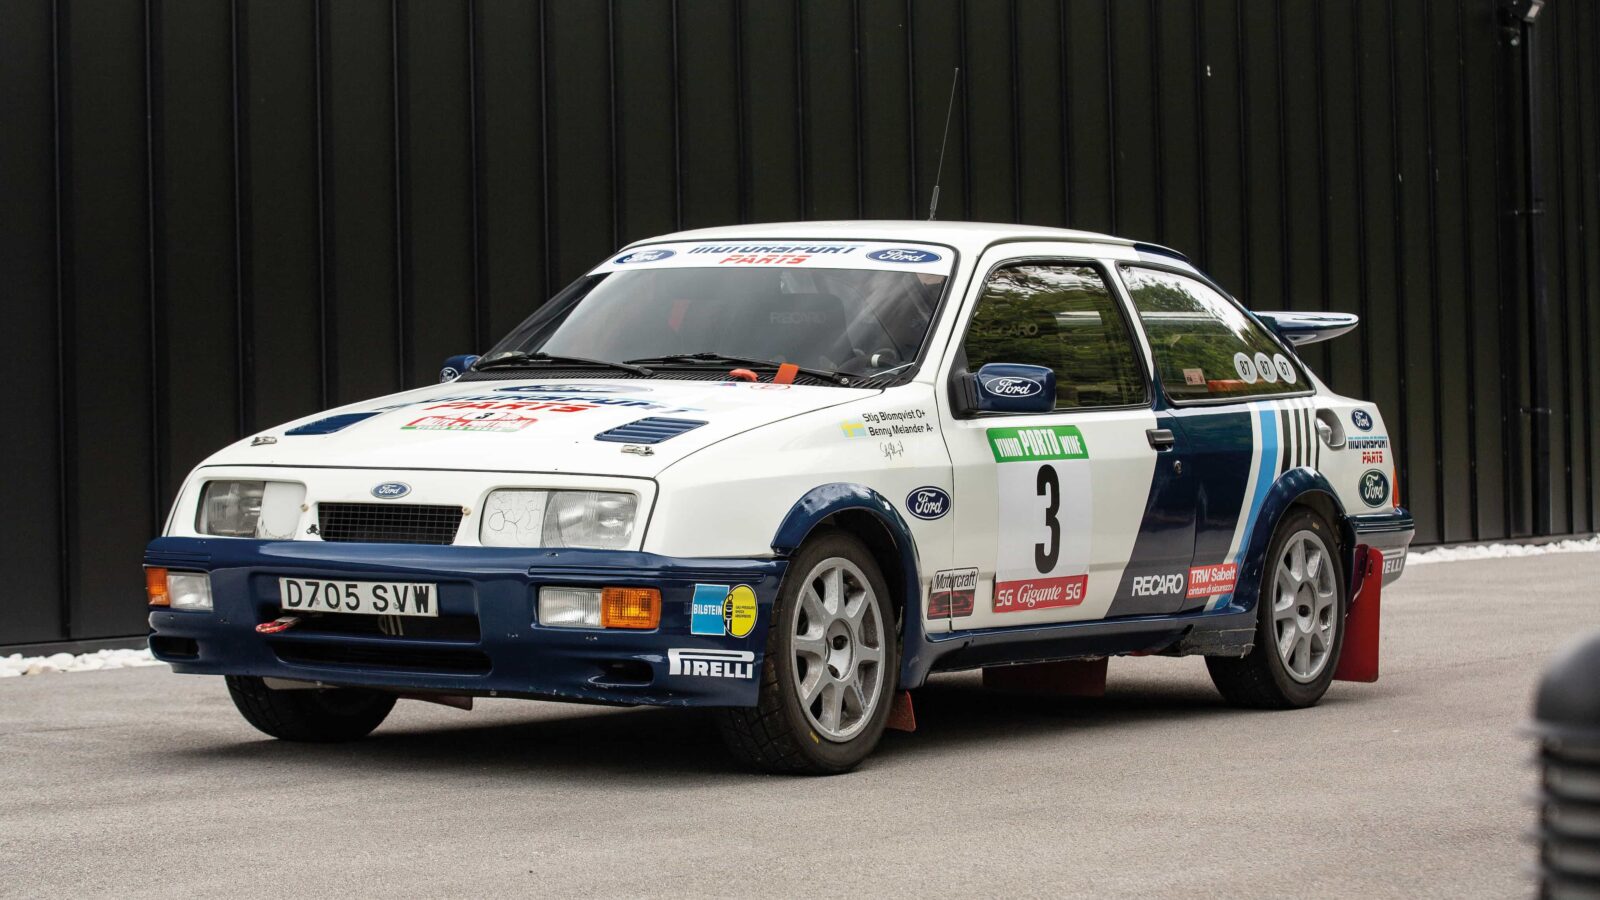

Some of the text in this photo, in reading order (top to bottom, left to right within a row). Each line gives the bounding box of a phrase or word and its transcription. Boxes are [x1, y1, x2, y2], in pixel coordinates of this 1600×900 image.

[688, 243, 866, 254] MOTORSPORT
[879, 249, 925, 262] Ford
[719, 254, 812, 264] PARTS
[1240, 360, 1251, 376] 87
[1260, 360, 1271, 376] 87
[1279, 361, 1291, 377] 87
[995, 379, 1031, 394] Ford
[424, 401, 602, 413] PARTS
[862, 413, 880, 423] Stig
[879, 409, 916, 422] Blomqvist
[1354, 411, 1369, 428] Ford
[868, 423, 934, 437] Benny Melander A-
[1018, 429, 1061, 456] PORTO
[1059, 435, 1083, 455] WINE
[1348, 436, 1388, 450] MOTORSPORT
[1362, 451, 1383, 464] PARTS
[378, 485, 401, 494] Ford
[1364, 474, 1384, 500] Ford
[915, 491, 942, 514] Ford
[1034, 464, 1061, 574] 3
[934, 570, 976, 590] Motorcraft
[1191, 565, 1236, 584] TRW Sabelt
[1131, 573, 1184, 597] RECARO
[286, 579, 429, 614] D705 SVW
[996, 583, 1082, 608] SG Gigante SG
[693, 603, 722, 616] BILSTEIN
[668, 648, 755, 679] PIRELLI
